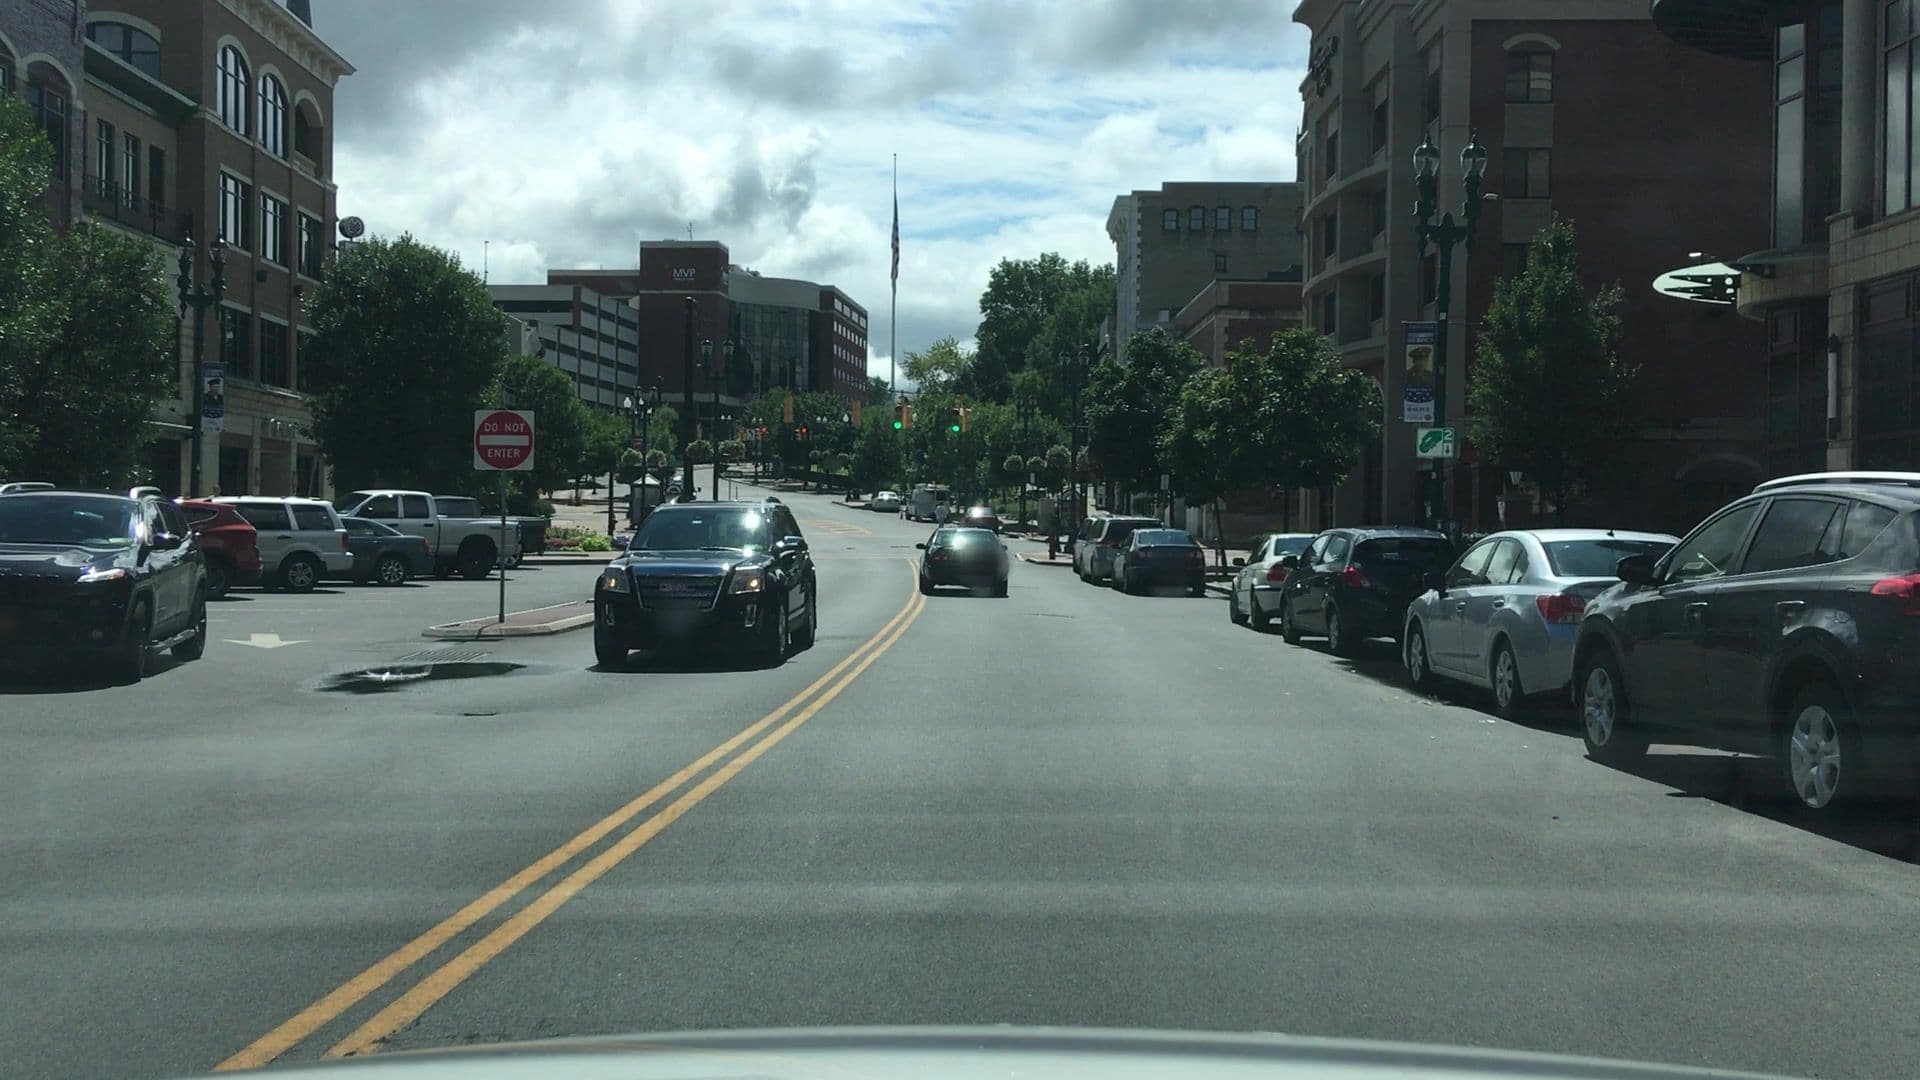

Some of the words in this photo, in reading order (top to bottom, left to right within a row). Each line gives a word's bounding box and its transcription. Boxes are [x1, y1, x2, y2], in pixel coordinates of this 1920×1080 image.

[672, 268, 696, 278] MVP
[484, 423, 498, 432] DO
[505, 423, 524, 432] NOT
[487, 448, 520, 458] ENTER
